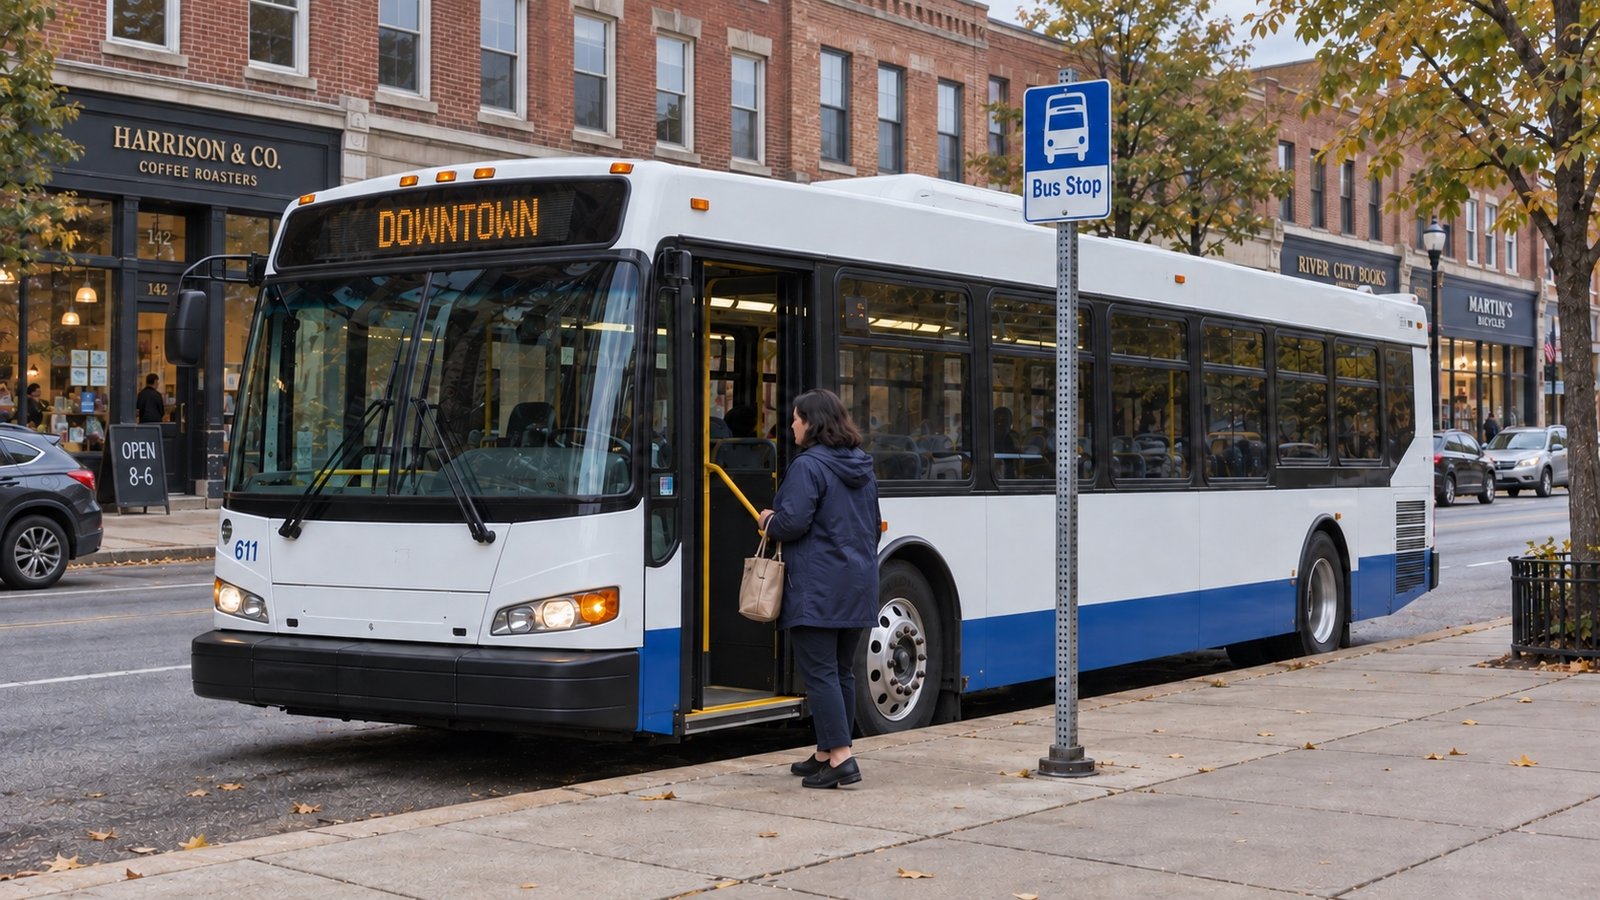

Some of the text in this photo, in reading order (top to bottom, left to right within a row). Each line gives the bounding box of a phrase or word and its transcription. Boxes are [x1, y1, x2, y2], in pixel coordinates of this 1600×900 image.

[113, 125, 282, 170] HARRISON & CO.
[139, 160, 258, 187] COFFEE ROASTERS
[1033, 175, 1102, 198] Bus Stop
[378, 198, 539, 248] DOWNTOWN
[147, 229, 172, 246] 142
[1298, 255, 1387, 287] RIVER CITY BOOKS
[147, 282, 168, 296] 142
[1469, 295, 1513, 319] MARTIN'S
[1477, 315, 1506, 329] BICYCLES
[121, 441, 156, 460] OPEN
[129, 466, 154, 486] 8-6
[234, 539, 258, 562] 611
